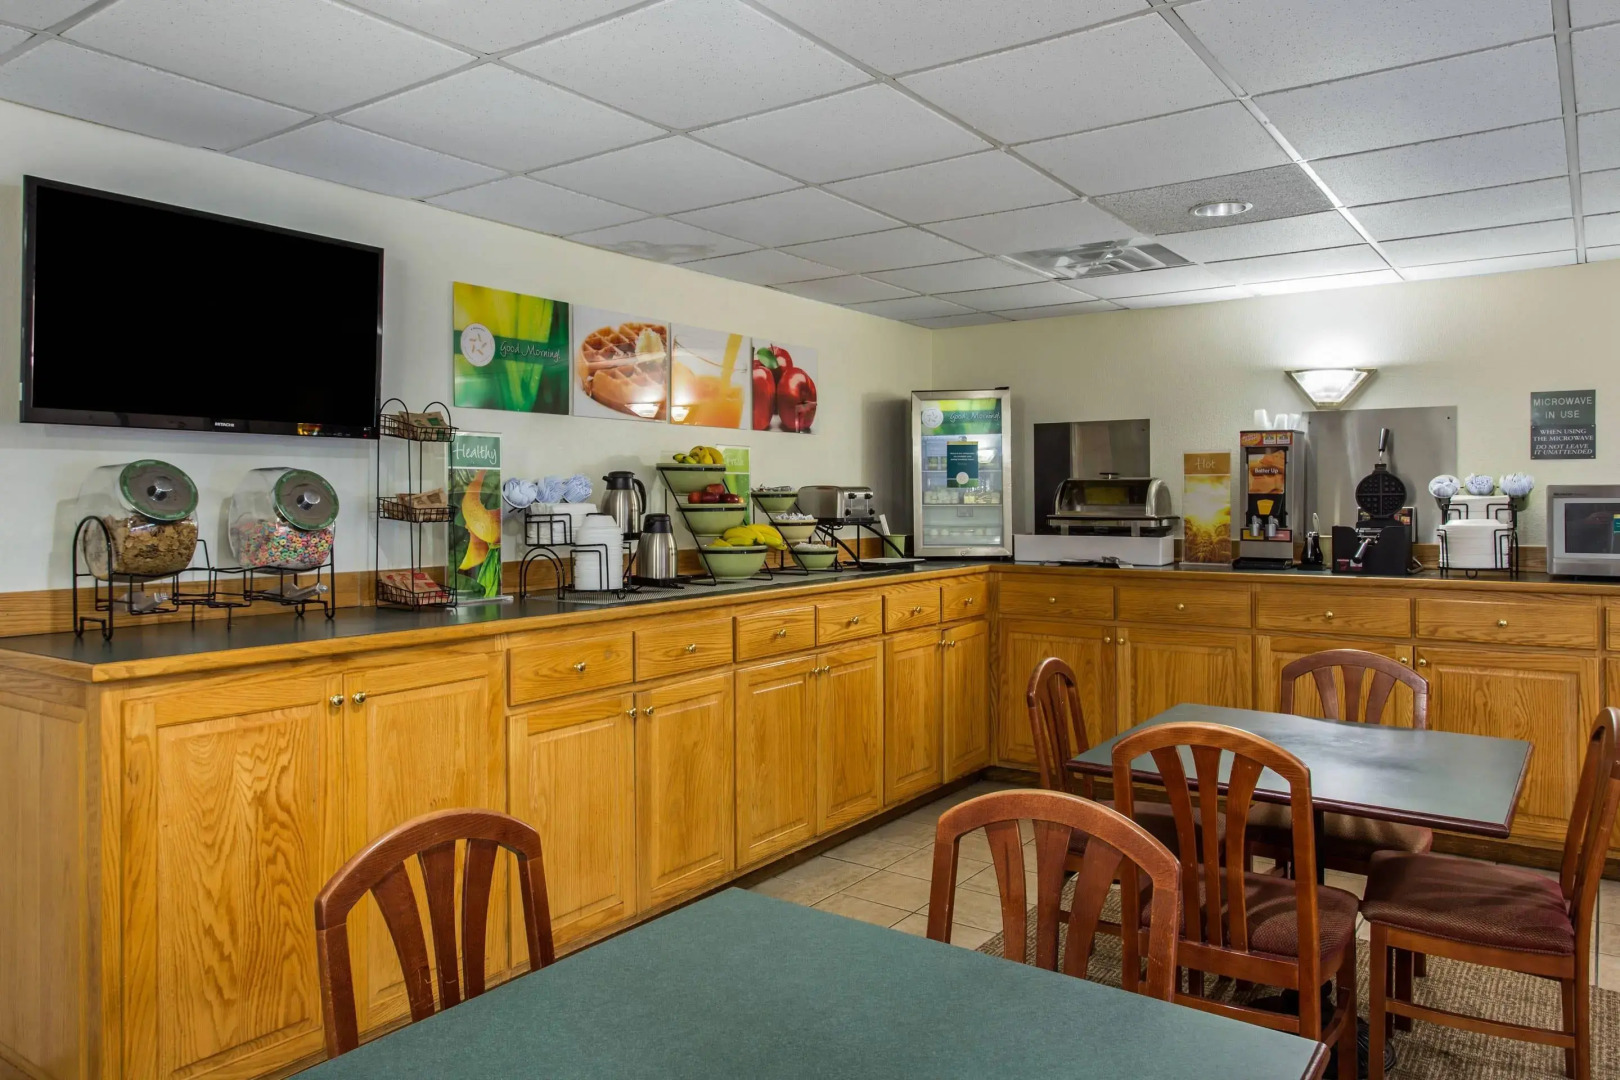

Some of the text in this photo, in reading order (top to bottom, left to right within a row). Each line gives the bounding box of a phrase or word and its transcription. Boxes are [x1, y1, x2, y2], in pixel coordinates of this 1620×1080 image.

[500, 340, 561, 363] Good Morning!
[1533, 396, 1593, 407] MICROWAVE
[1545, 410, 1580, 419] IN USE
[452, 442, 497, 465] Healthy
[1193, 457, 1216, 470] Hot
